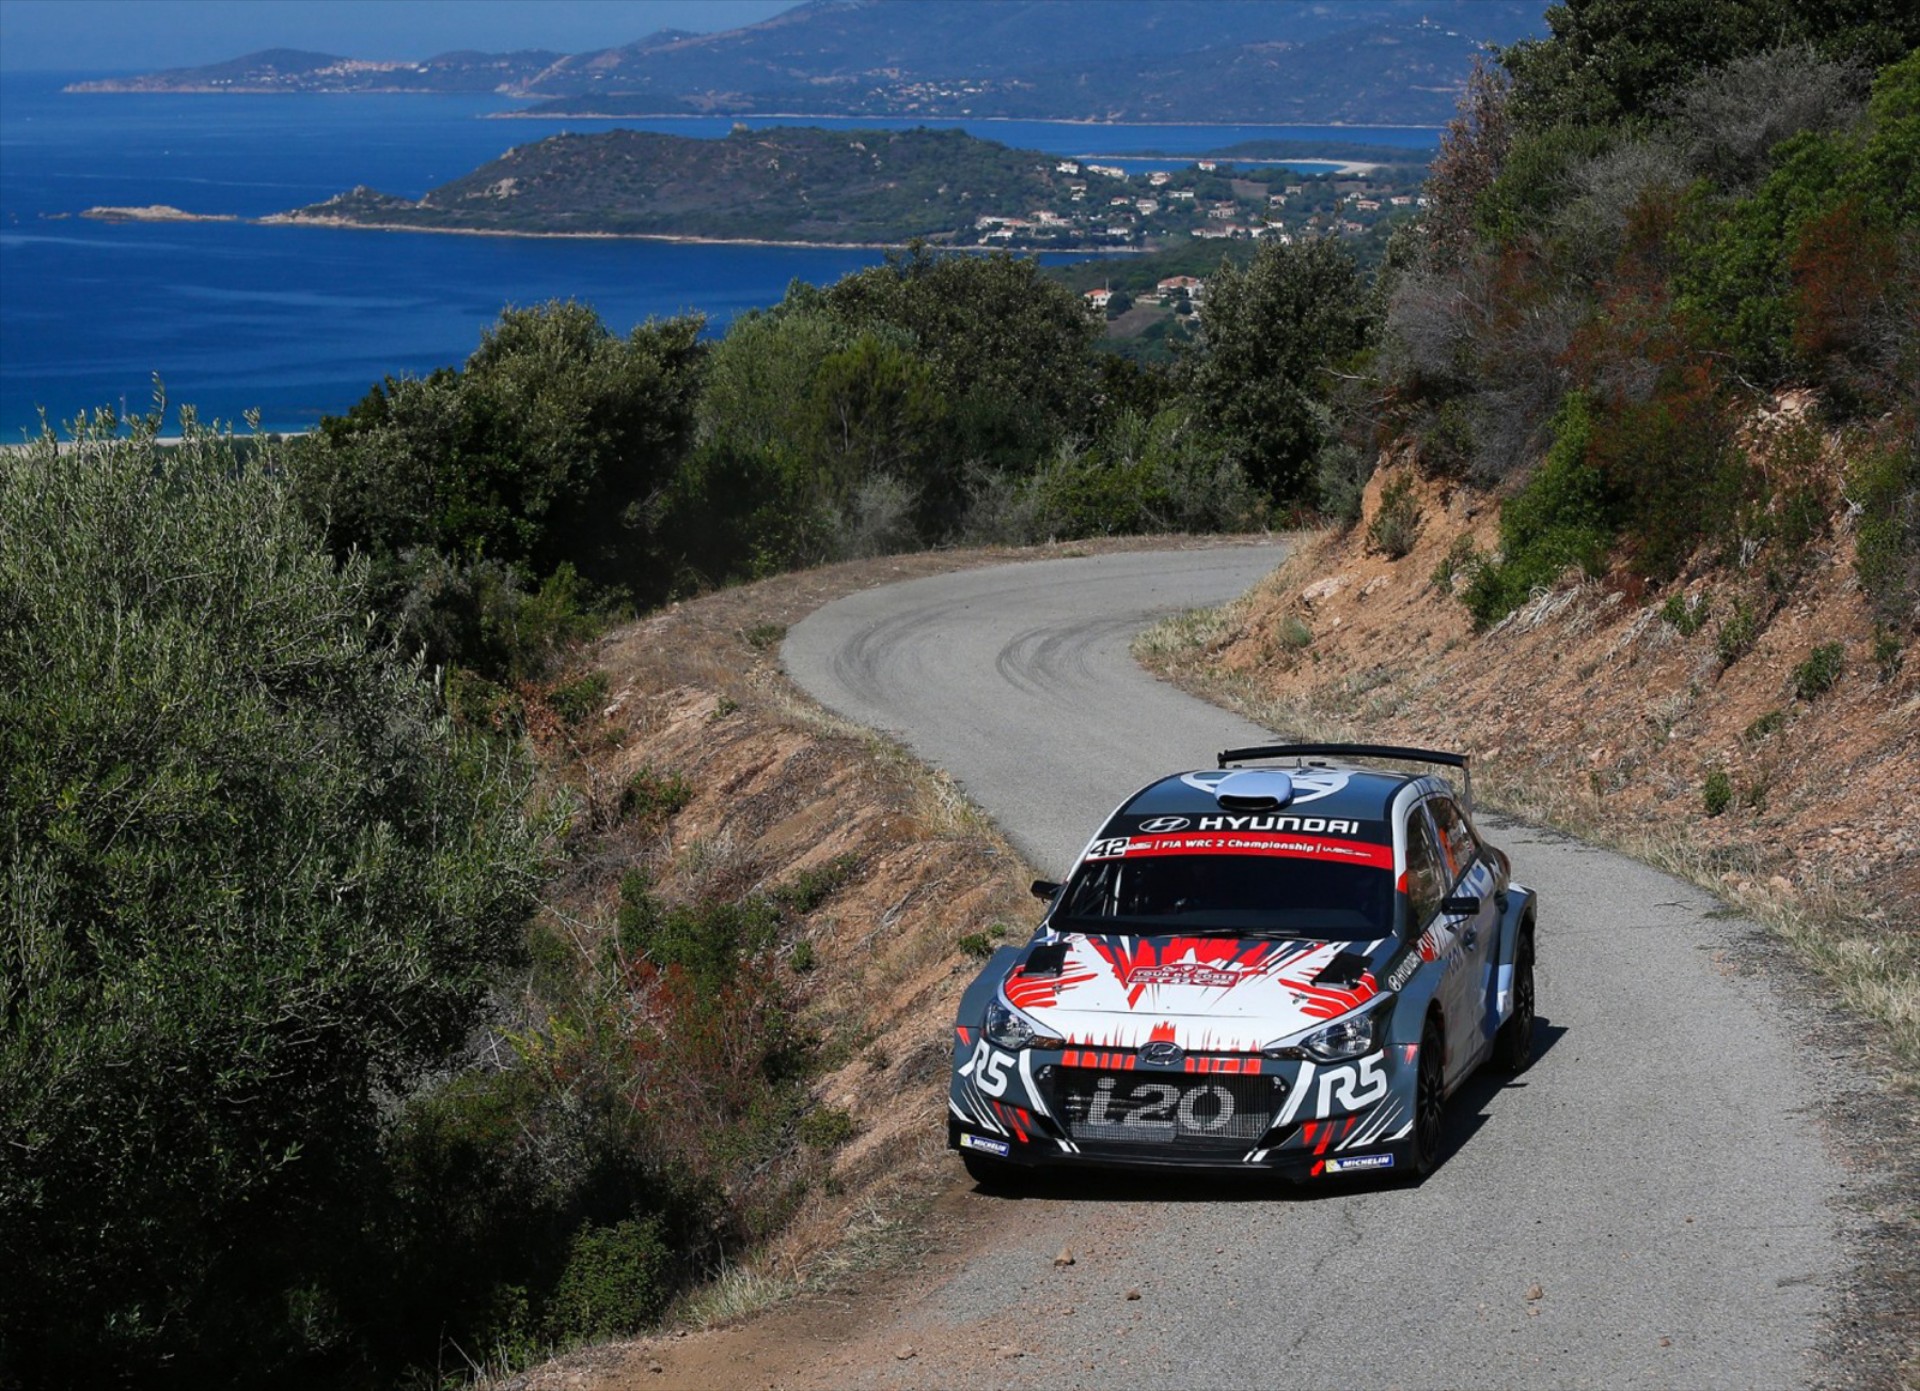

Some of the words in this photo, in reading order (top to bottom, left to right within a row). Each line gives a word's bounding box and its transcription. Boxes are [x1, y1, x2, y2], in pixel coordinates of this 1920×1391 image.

[1199, 816, 1359, 834] HYUNDAI
[1090, 839, 1128, 857] 42
[1161, 840, 1182, 848] FIA
[1185, 839, 1213, 848] WRC
[1216, 839, 1225, 847] 2
[1227, 839, 1315, 853] Championship
[1087, 1076, 1235, 1131] i20
[972, 1138, 1007, 1152] MICHELIN
[1342, 1156, 1389, 1168] MICHELIN
